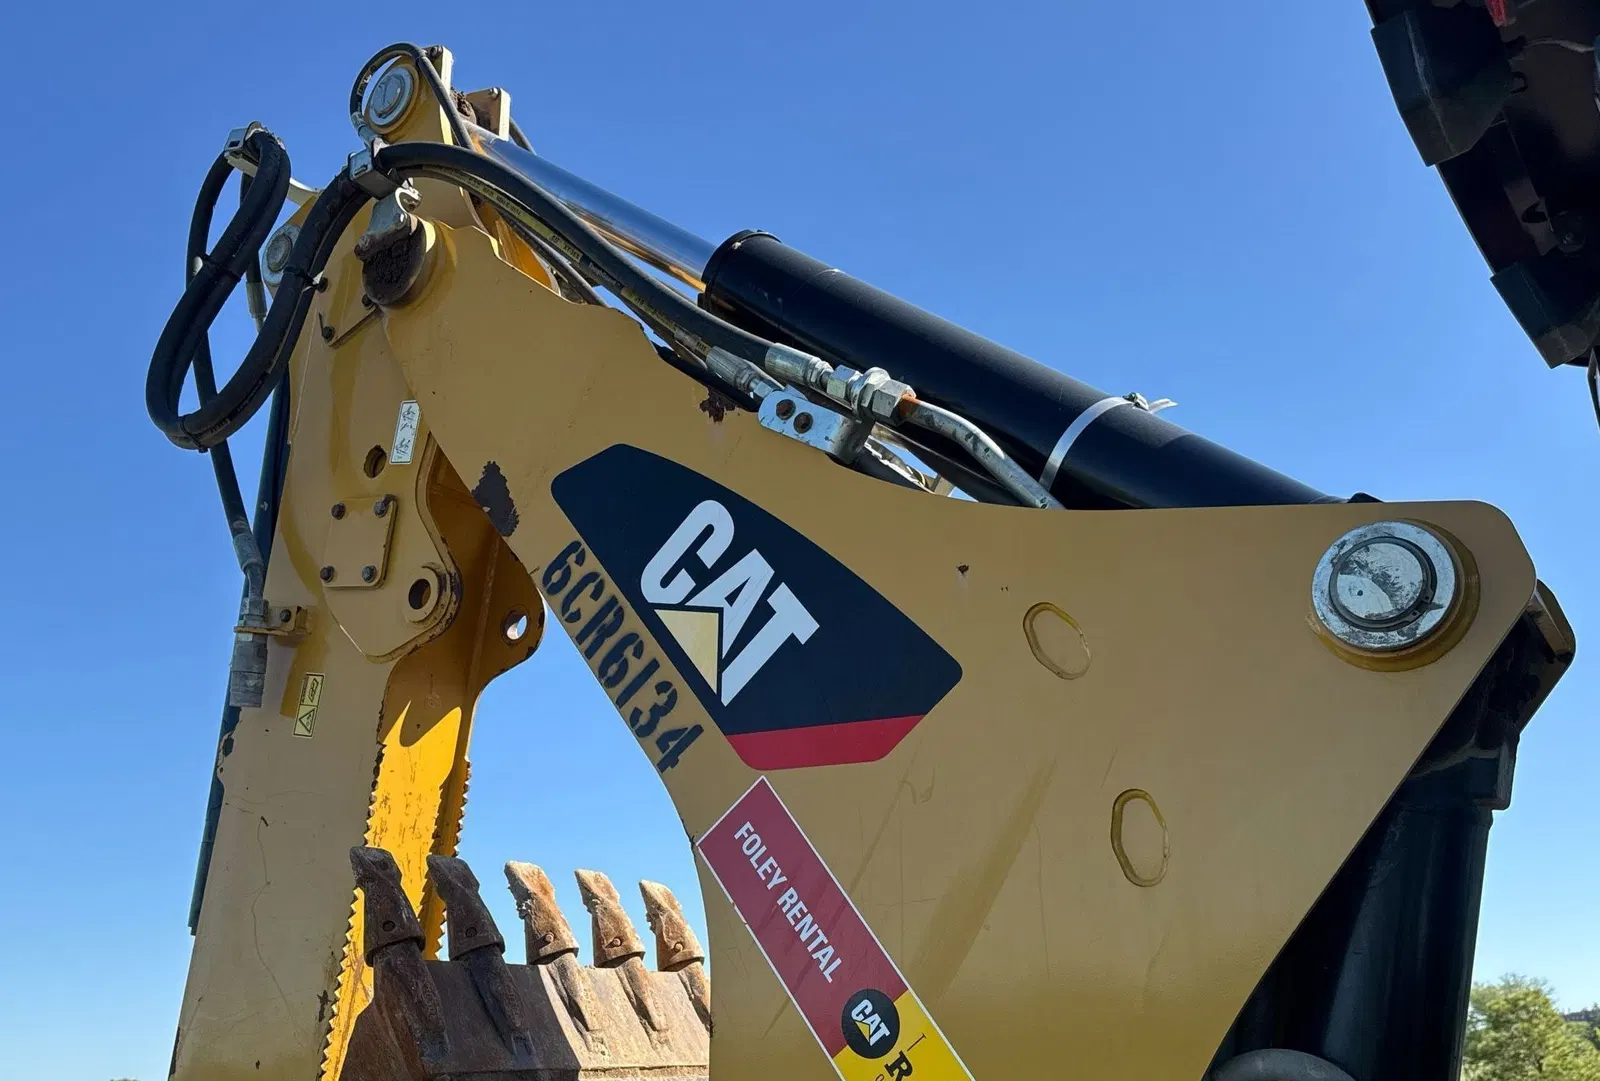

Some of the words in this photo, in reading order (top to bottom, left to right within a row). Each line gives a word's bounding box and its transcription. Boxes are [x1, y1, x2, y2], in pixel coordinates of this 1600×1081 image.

[543, 540, 703, 773] 6CR6134
[641, 500, 820, 707] CAT
[734, 822, 787, 890] FOLEY
[777, 887, 842, 982] RENTAL
[851, 999, 890, 1046] CAT
